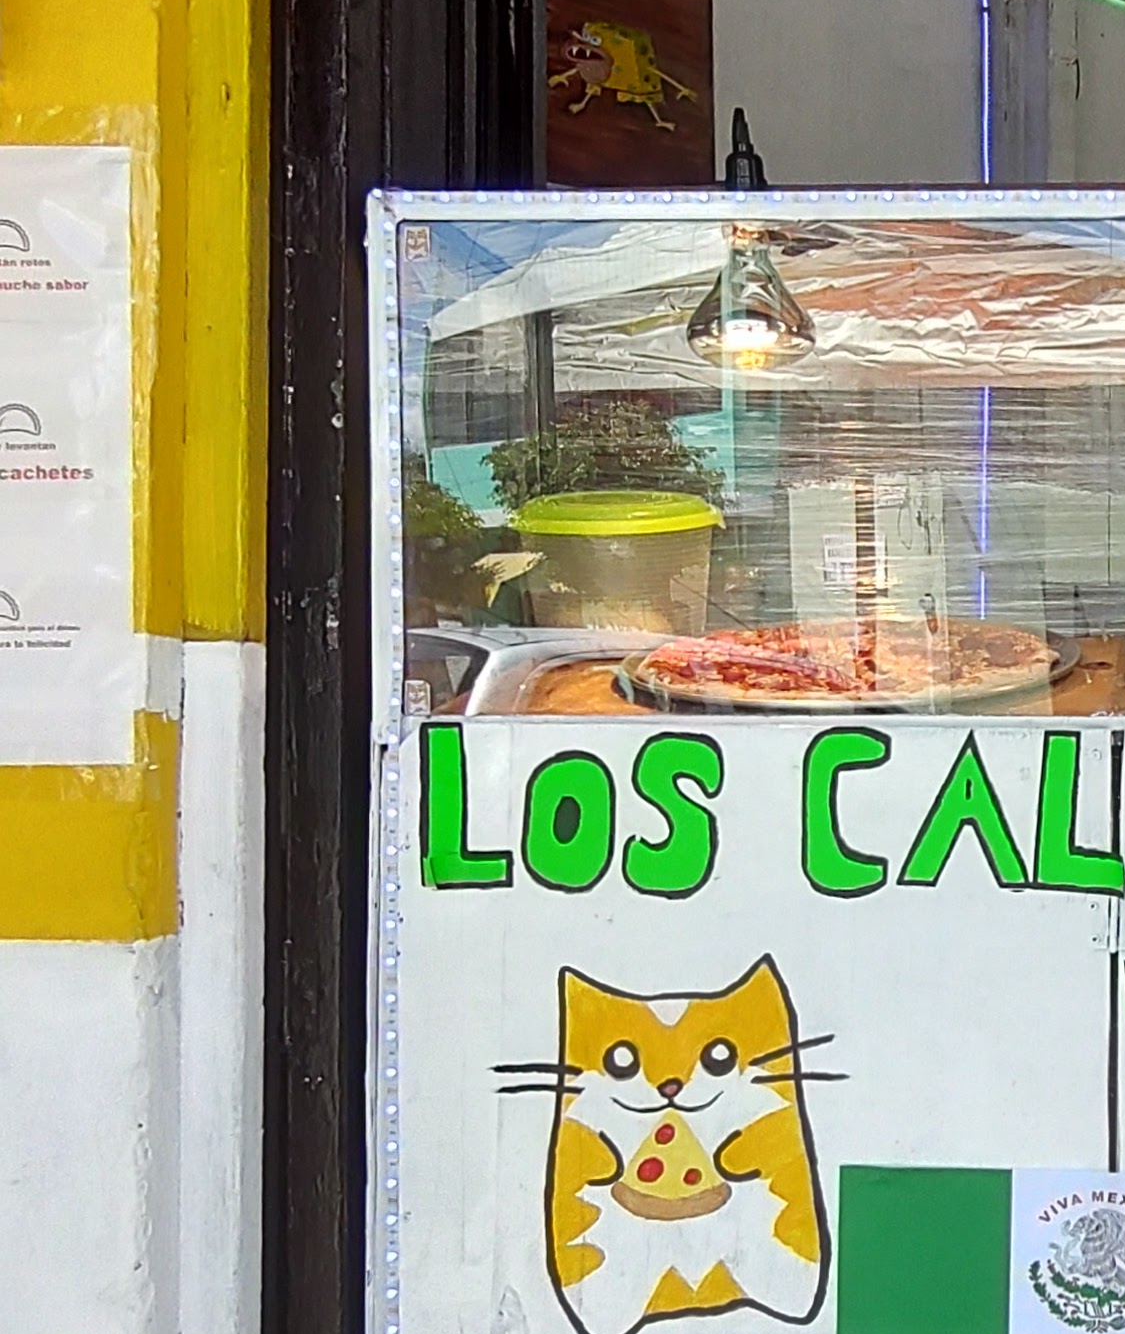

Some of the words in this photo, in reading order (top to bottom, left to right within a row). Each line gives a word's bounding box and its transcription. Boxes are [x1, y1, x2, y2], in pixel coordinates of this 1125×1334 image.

[20, 258, 51, 267] rotos
[46, 278, 89, 291] sabor
[419, 724, 724, 900] LOS
[1038, 1193, 1083, 1224] VIVA
